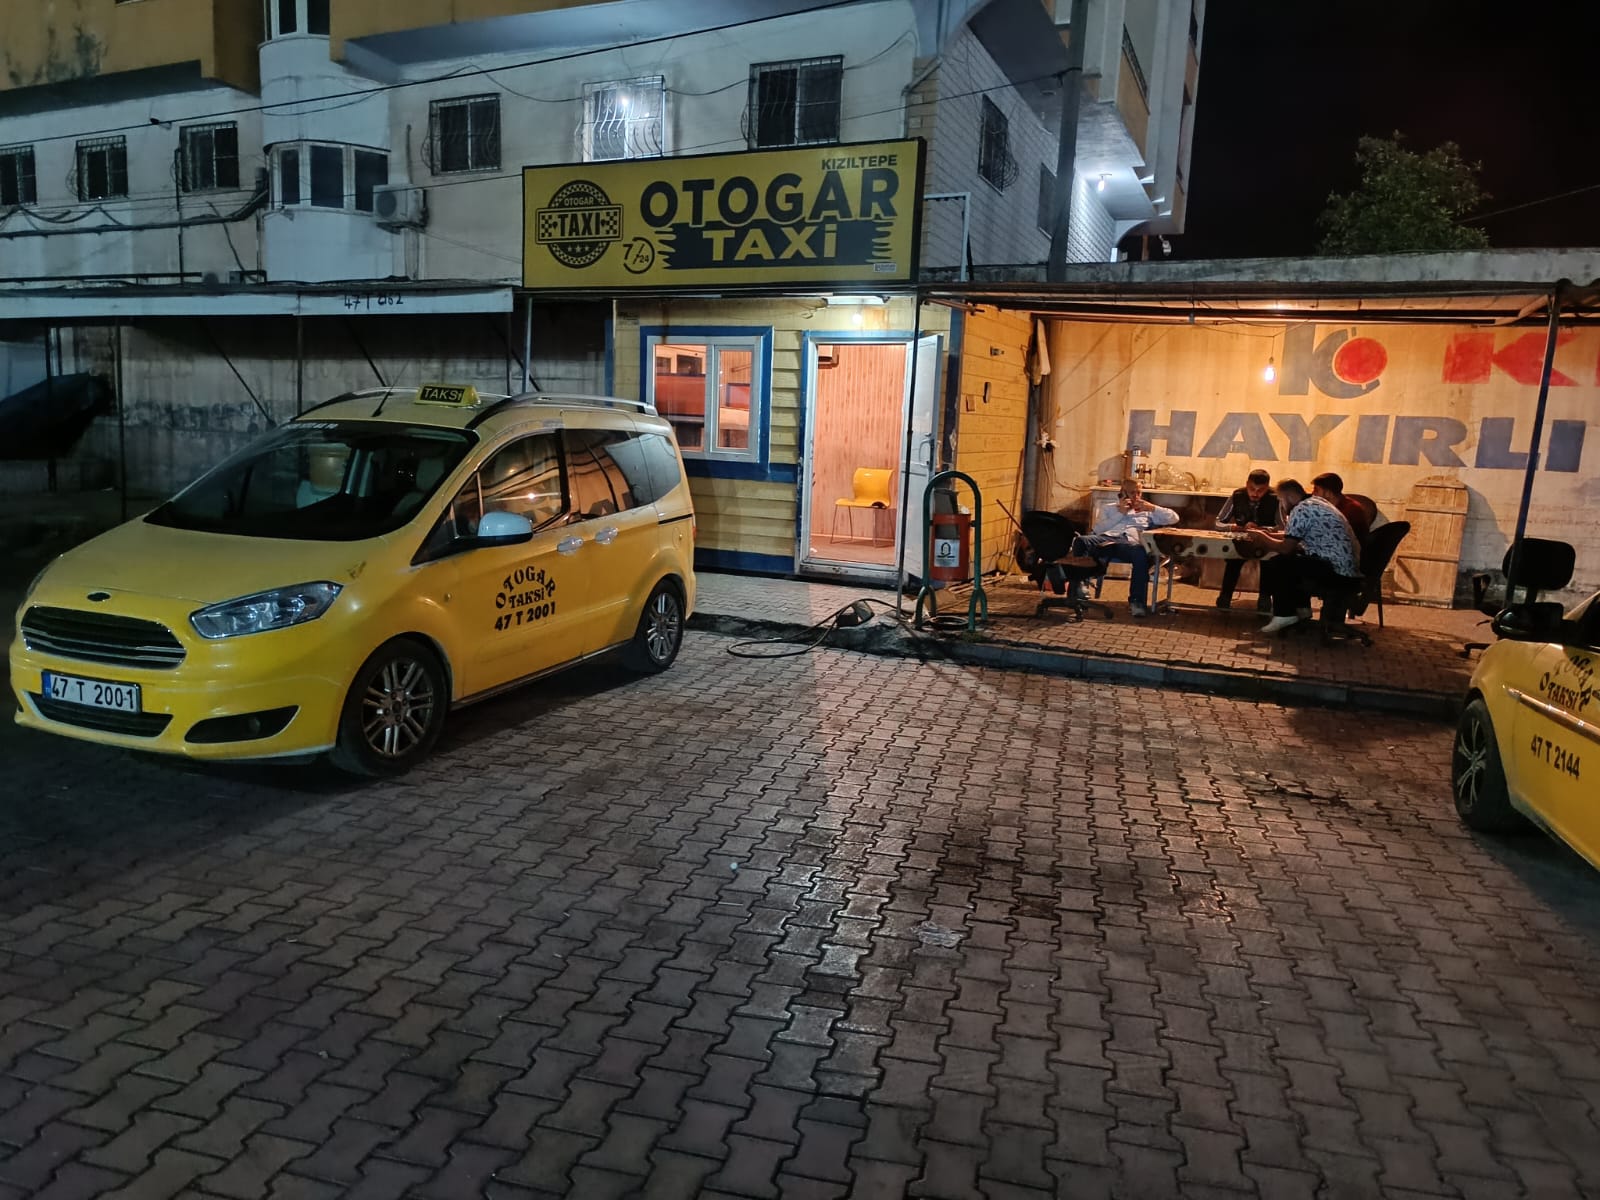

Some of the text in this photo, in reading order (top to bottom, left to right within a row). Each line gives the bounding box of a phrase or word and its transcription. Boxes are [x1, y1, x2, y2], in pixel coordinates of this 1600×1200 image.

[821, 154, 898, 171] KIZILTEPE
[563, 197, 595, 207] OTOGAR
[640, 168, 899, 229] OTOGAR
[558, 212, 601, 237] TAXI
[1126, 409, 1587, 473] HAYIRLI
[496, 566, 556, 609] OTOGAR
[495, 601, 556, 631] 47 T 2001
[52, 677, 68, 698] 47
[76, 681, 85, 701] T
[94, 684, 134, 709] 2001
[1531, 734, 1580, 779] 47 T 2144
